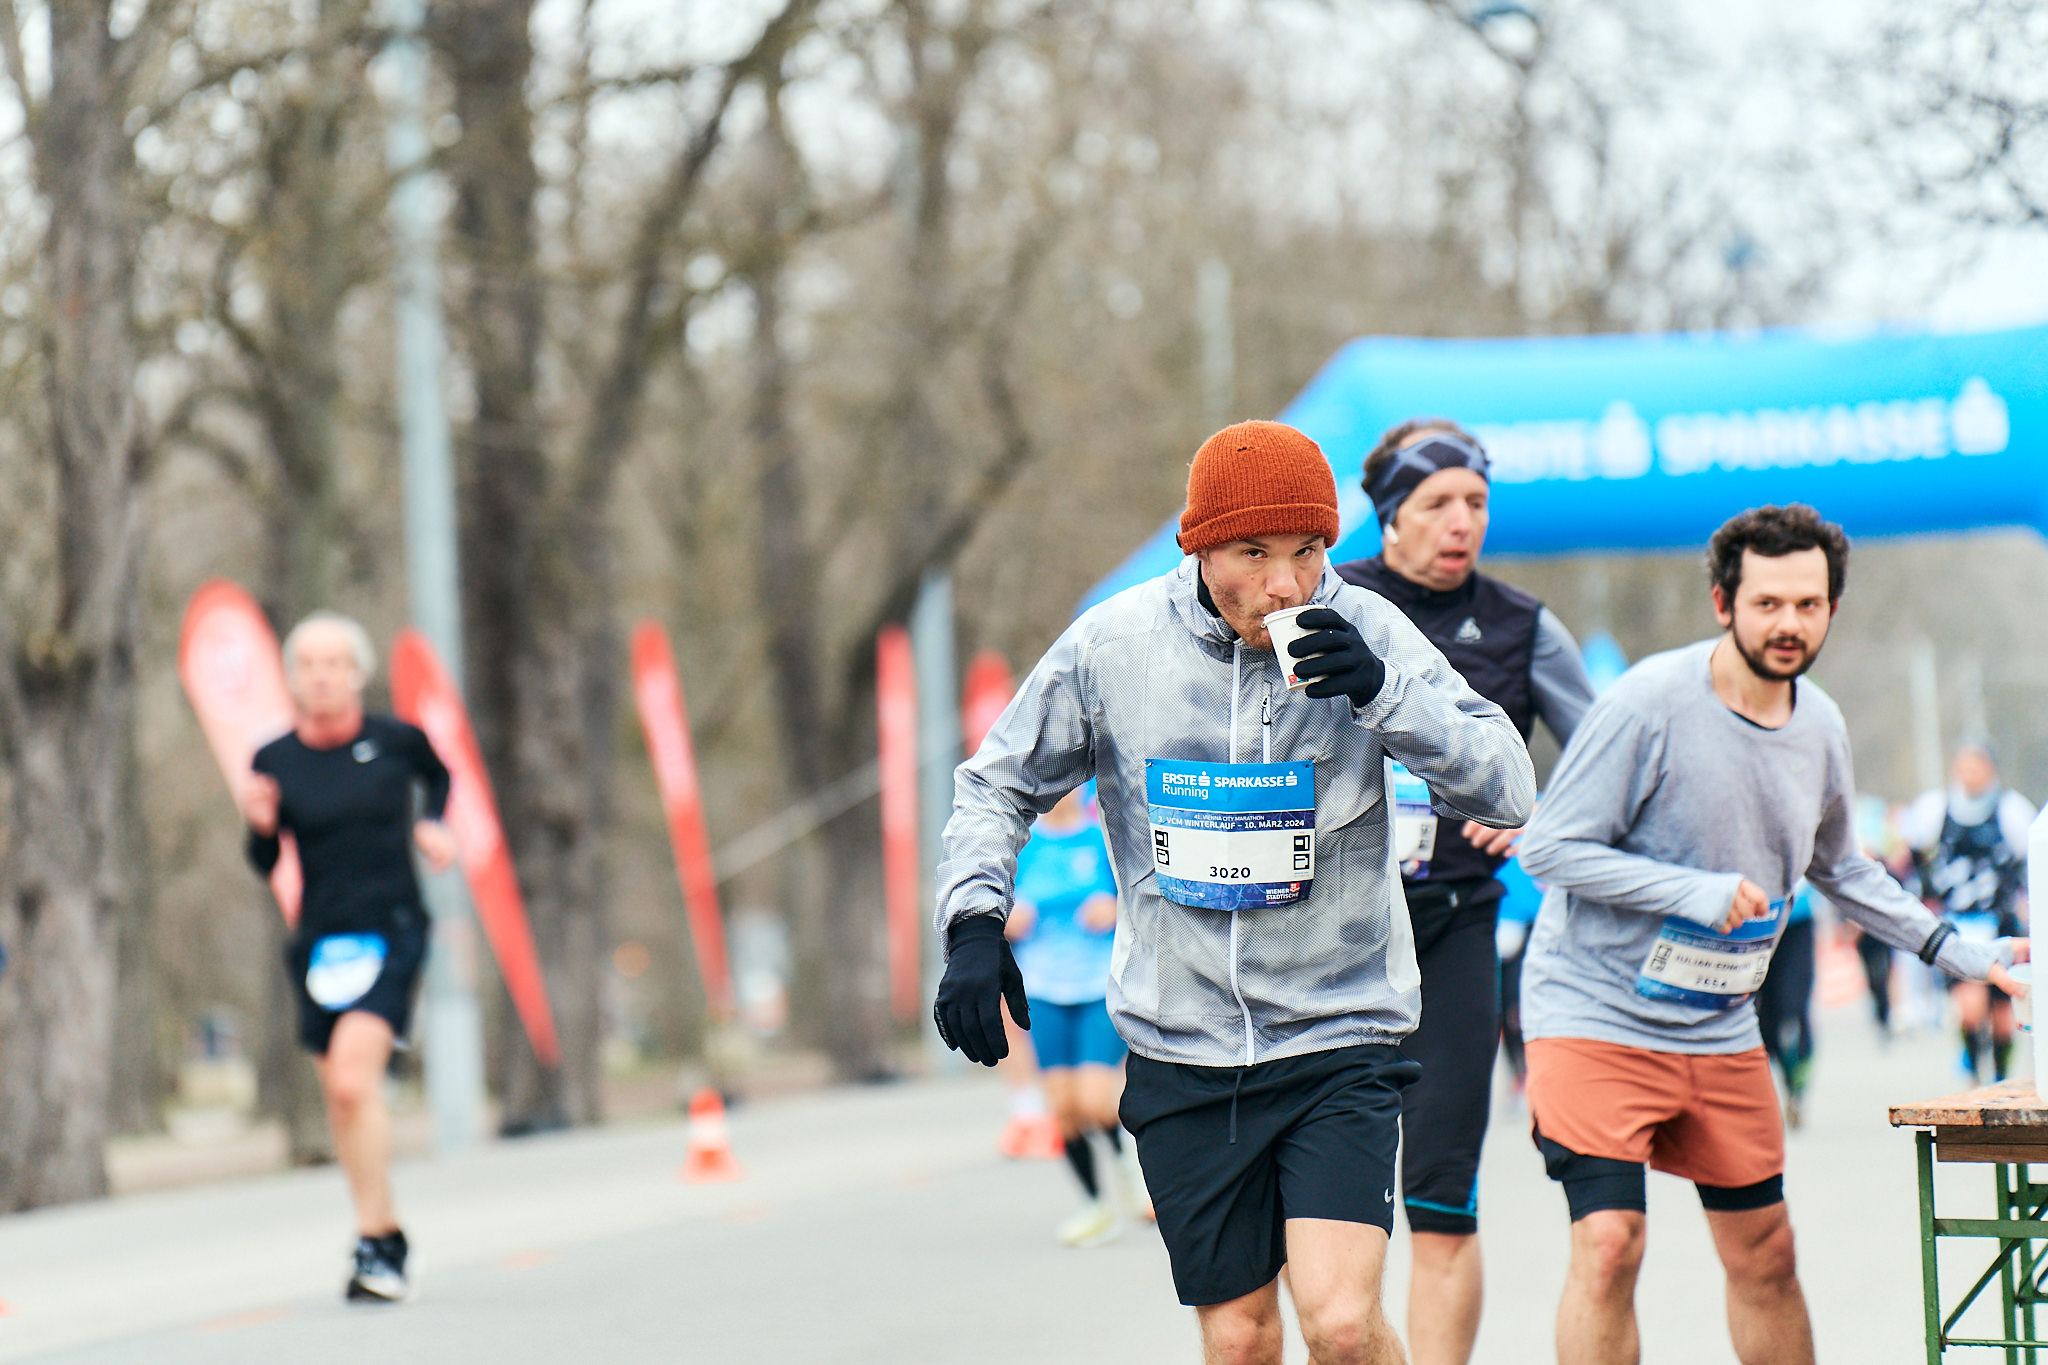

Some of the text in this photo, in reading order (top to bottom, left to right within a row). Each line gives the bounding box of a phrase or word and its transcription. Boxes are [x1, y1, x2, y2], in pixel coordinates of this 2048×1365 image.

[1656, 399, 1948, 476] SPARKASSE
[1163, 772, 1285, 788] ERSTE SPARKASSE
[1163, 784, 1209, 800] Running
[1158, 815, 1165, 824] 3.
[1167, 817, 1183, 826] VCM
[1184, 819, 1236, 830] WINTERLAUF
[1245, 821, 1257, 829] 10.
[1259, 819, 1283, 828] MÄRZ
[1285, 819, 1305, 827] 2024
[1209, 866, 1251, 879] 3020
